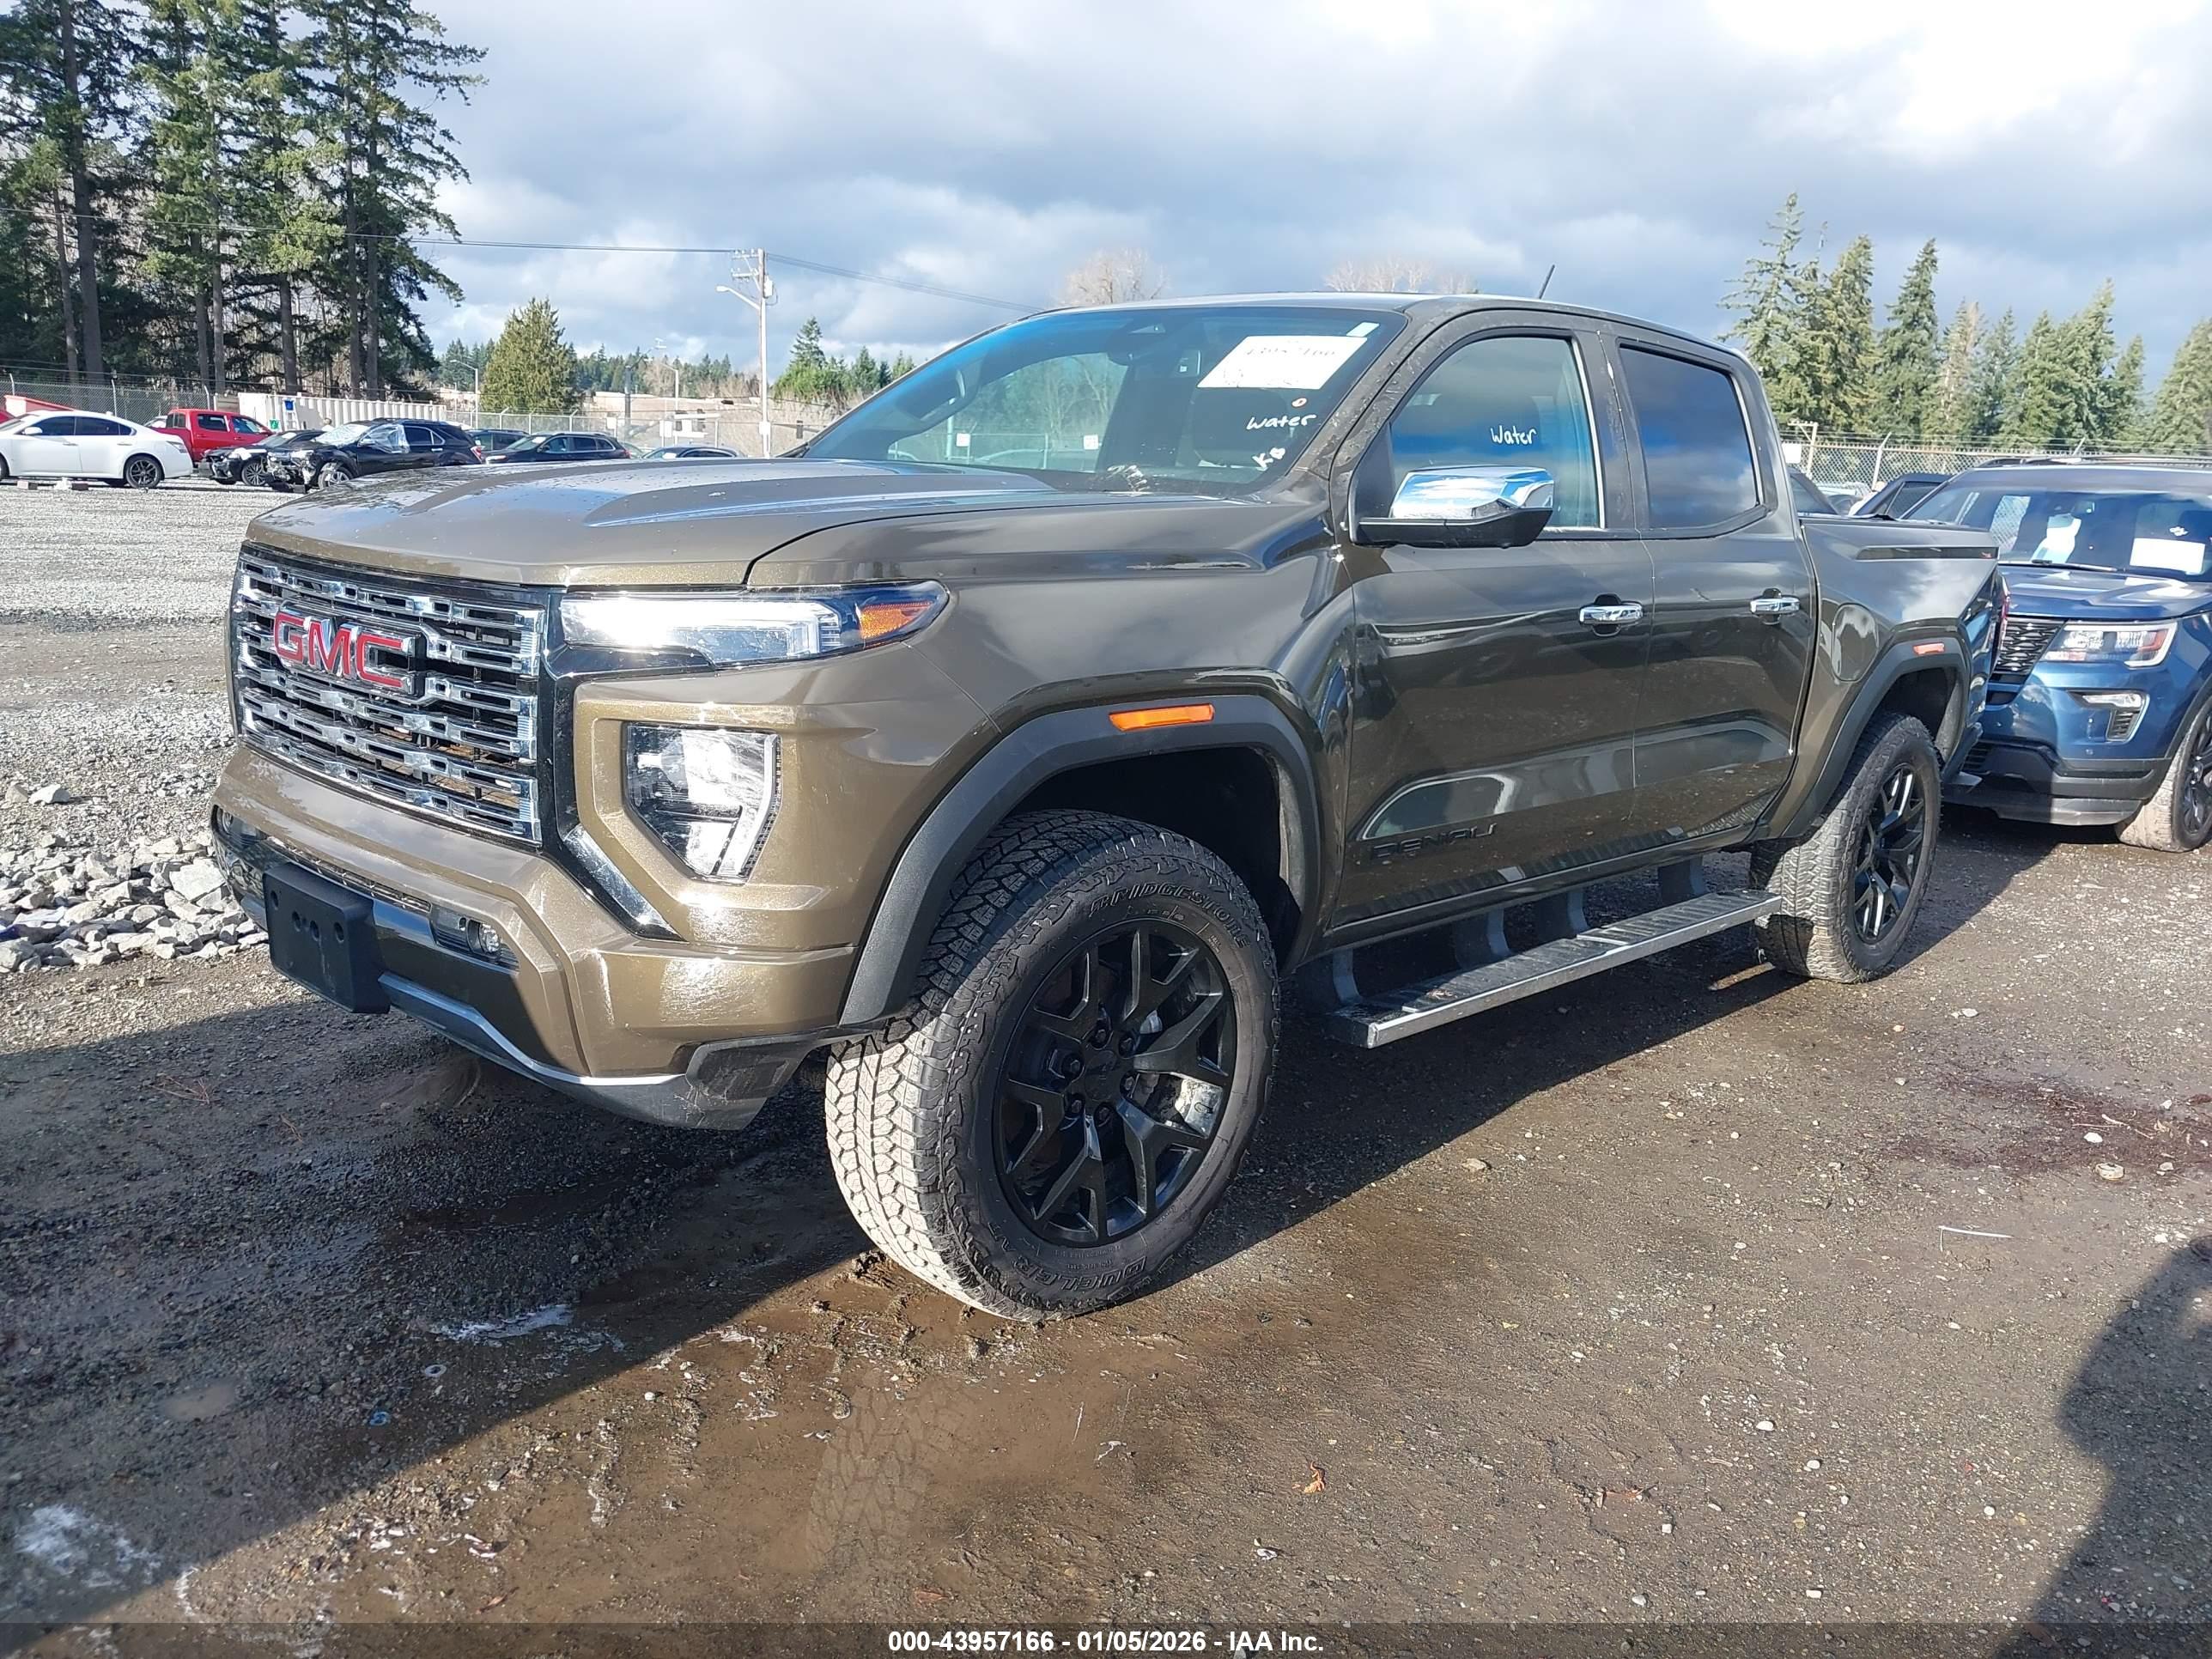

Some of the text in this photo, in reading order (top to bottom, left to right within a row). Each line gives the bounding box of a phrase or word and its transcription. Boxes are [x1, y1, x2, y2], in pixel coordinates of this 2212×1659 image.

[1245, 414, 1316, 430] water
[273, 611, 413, 691] GMC
[1088, 881, 1251, 949] BRIDGESTONE
